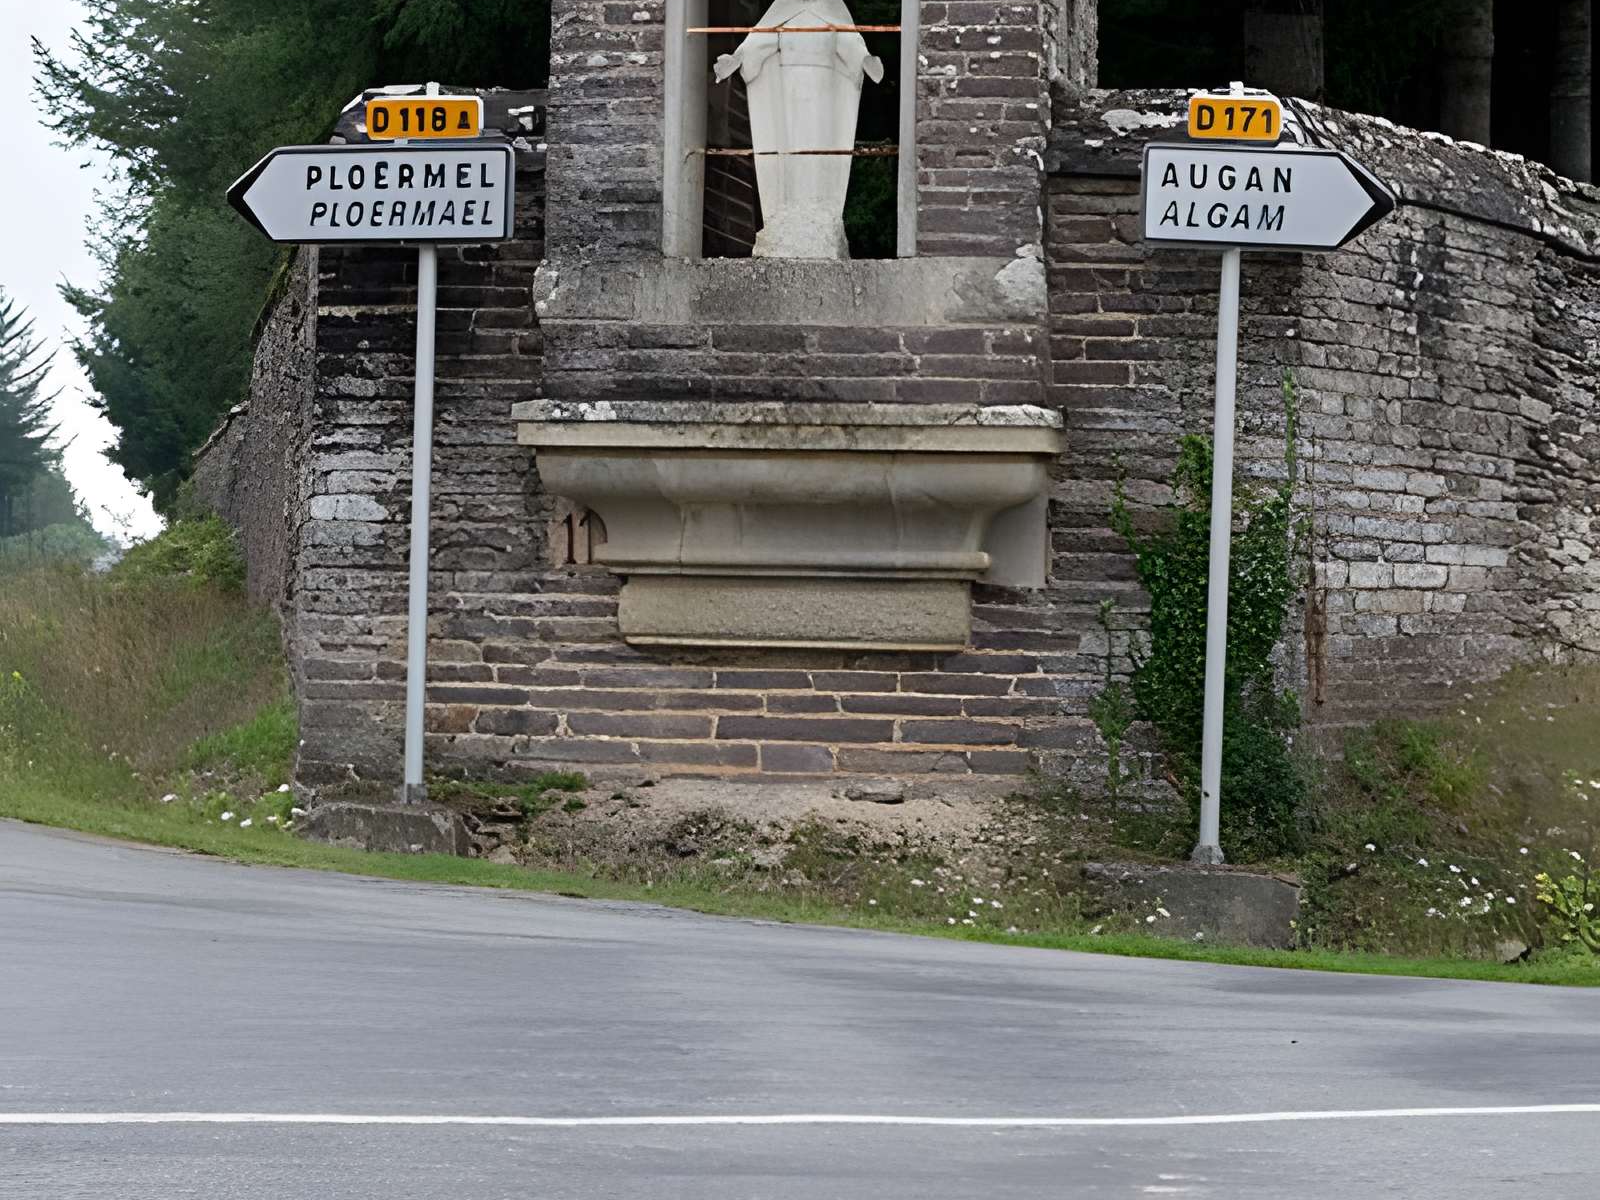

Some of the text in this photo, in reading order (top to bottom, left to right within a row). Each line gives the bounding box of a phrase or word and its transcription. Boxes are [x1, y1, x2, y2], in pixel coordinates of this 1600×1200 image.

[372, 106, 389, 132] D
[399, 106, 447, 132] 118
[1196, 104, 1273, 134] D 171
[1161, 162, 1292, 193] AUGAN
[310, 200, 493, 227] PLOERMAEL
[1159, 200, 1285, 231] ALGAM
